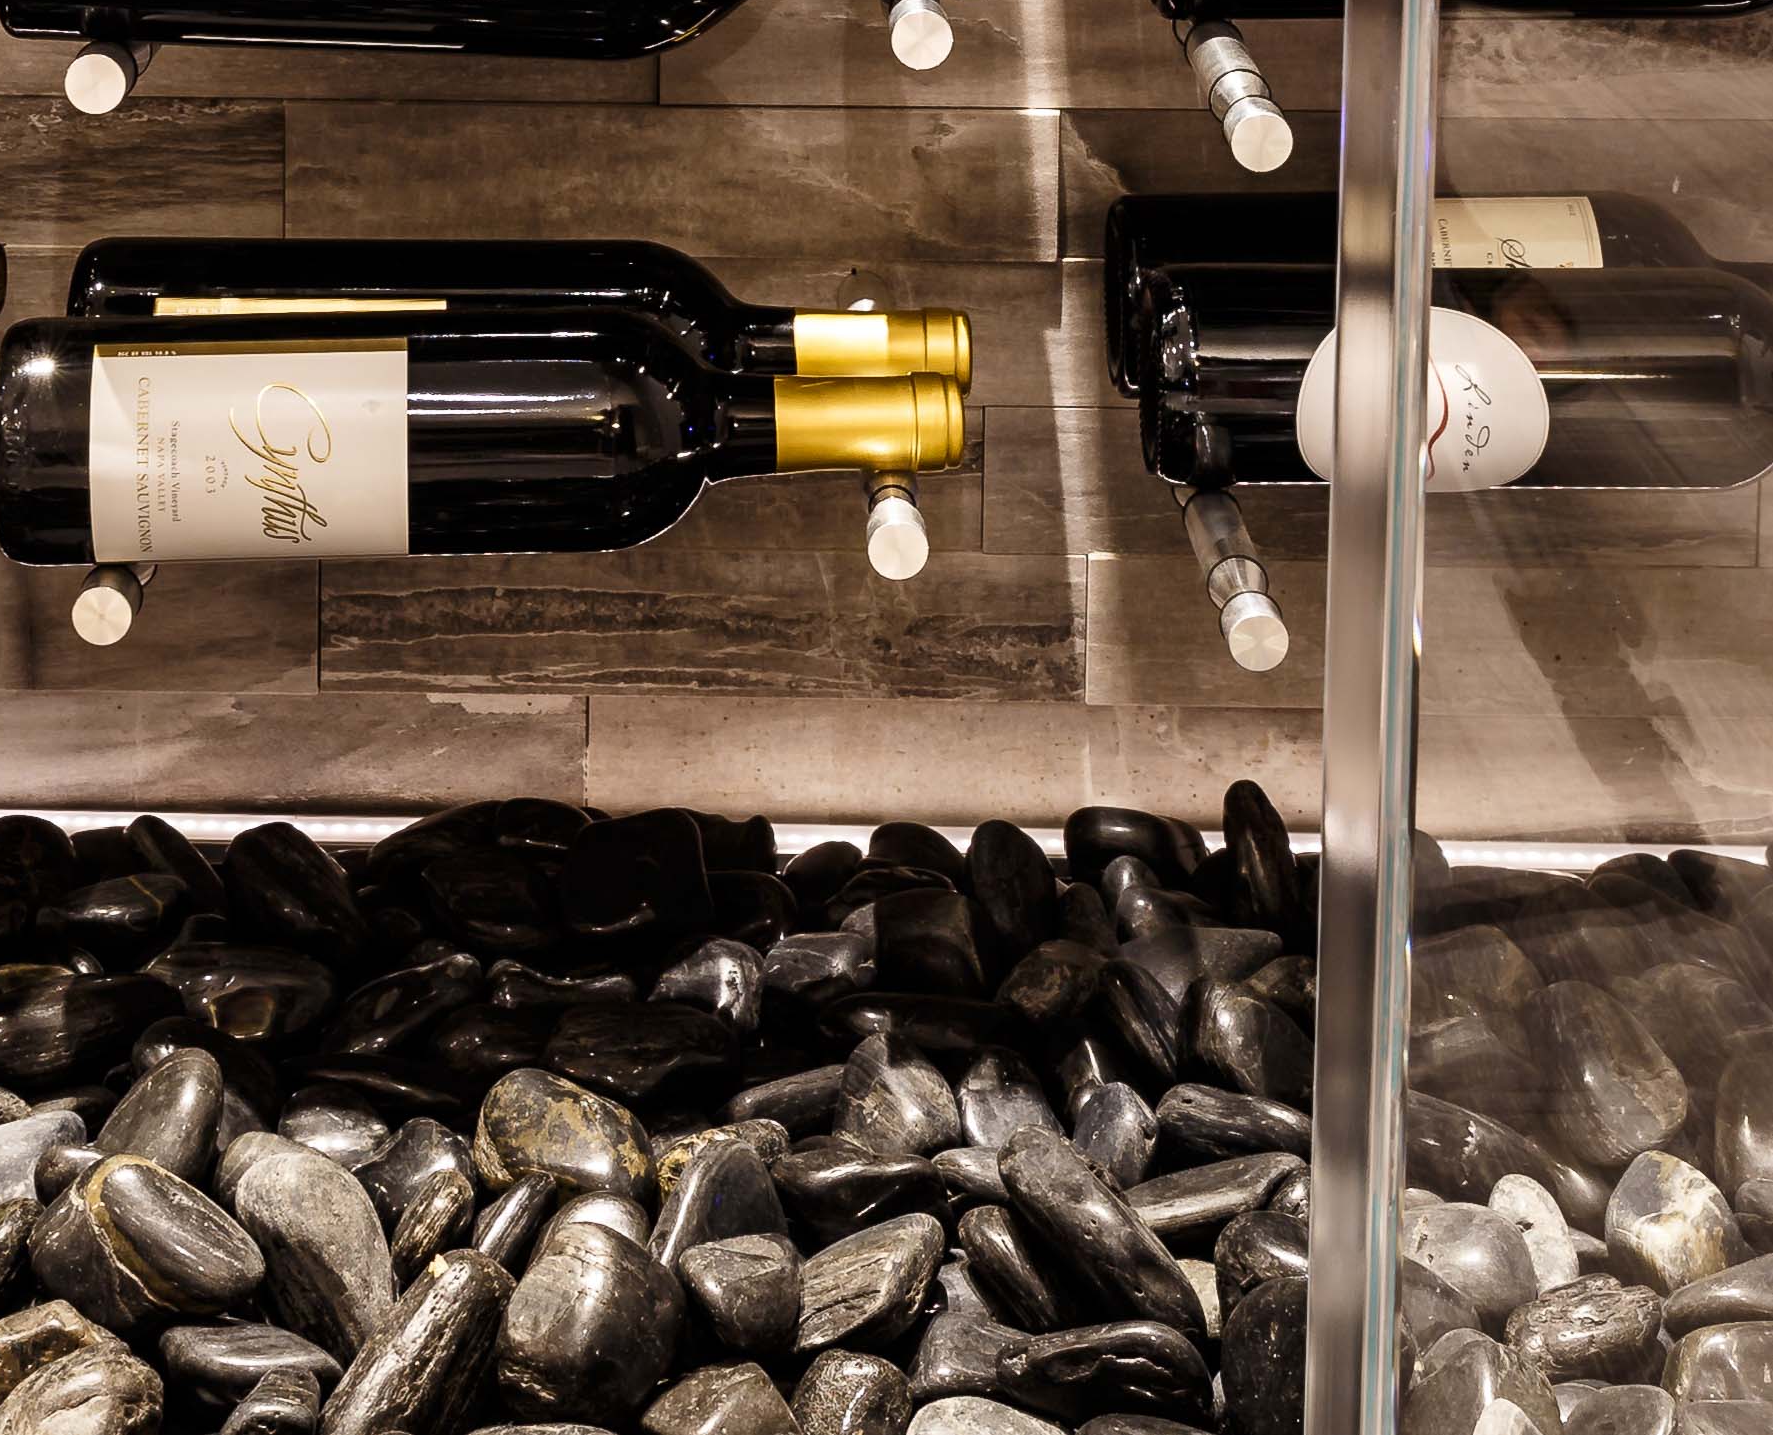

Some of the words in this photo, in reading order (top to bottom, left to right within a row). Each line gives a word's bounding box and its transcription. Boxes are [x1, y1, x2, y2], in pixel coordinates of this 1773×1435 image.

[137, 377, 152, 466] CABERNET
[156, 437, 165, 466] NAPA
[170, 420, 181, 482] Stagecoach
[156, 473, 165, 513] VALLEY
[205, 455, 216, 495] 2003
[135, 473, 153, 553] SAUVIGNON
[171, 486, 182, 523] Vineyard
